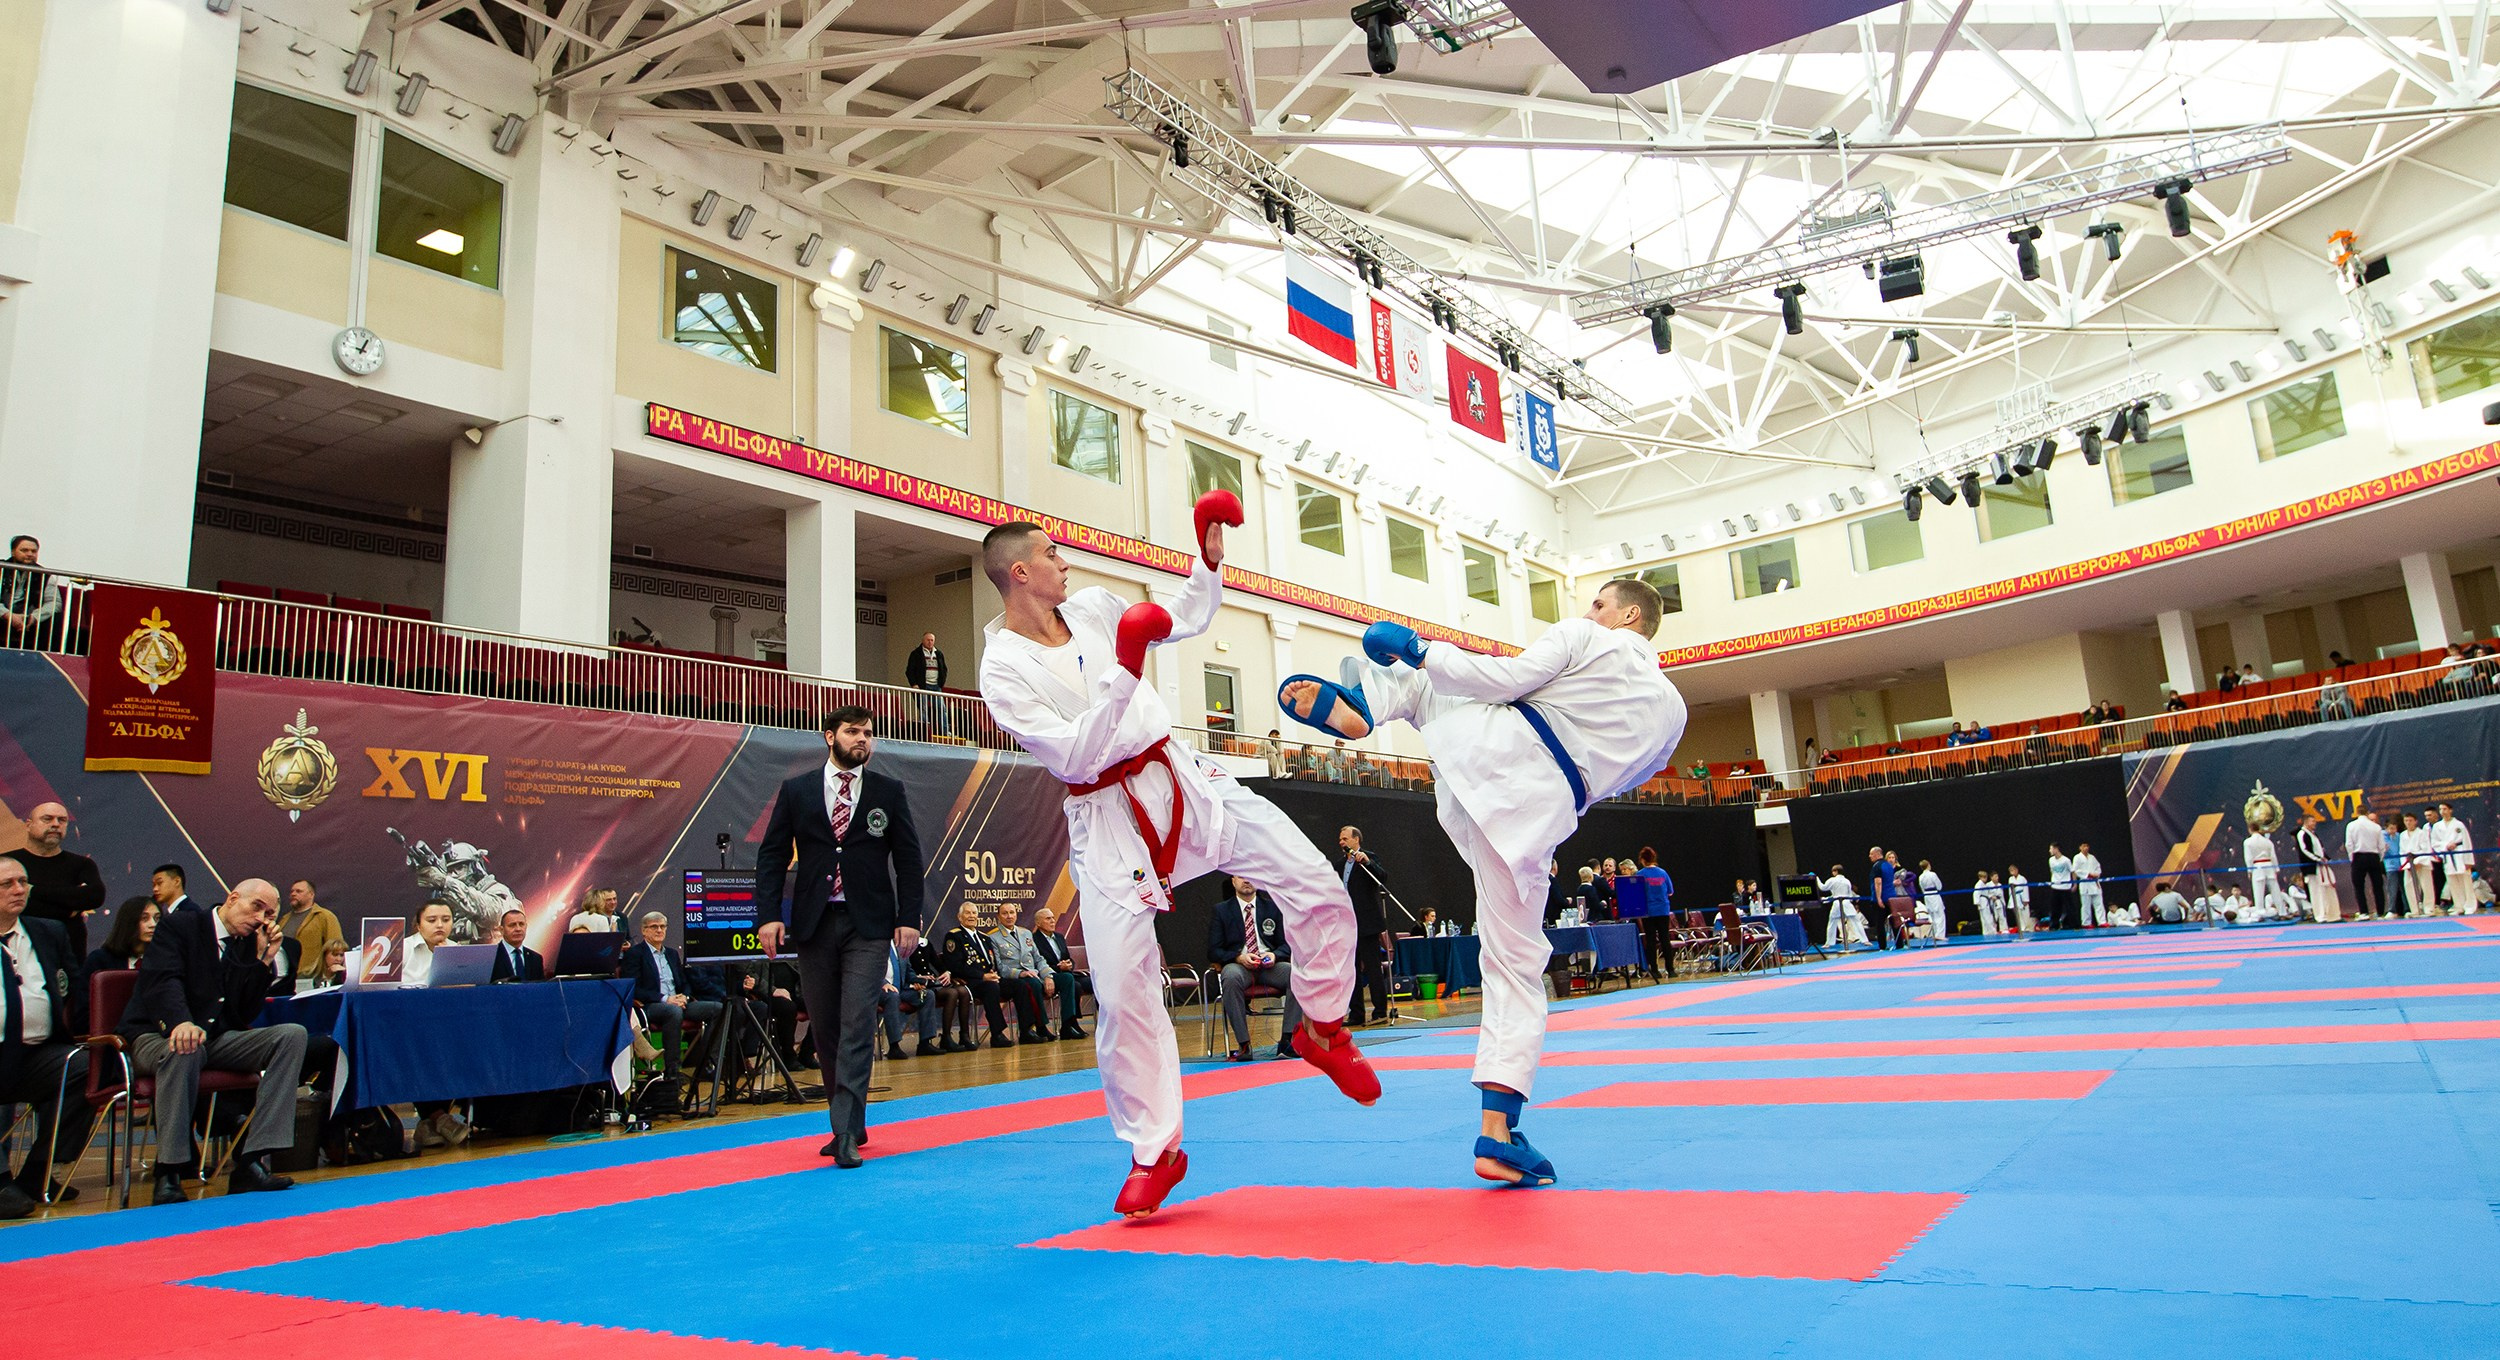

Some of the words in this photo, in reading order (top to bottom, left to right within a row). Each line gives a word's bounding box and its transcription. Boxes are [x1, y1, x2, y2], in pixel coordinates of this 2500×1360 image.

[650, 405, 686, 435] РА
[692, 416, 792, 461] "АЛЬФА"
[803, 447, 880, 486] ТУРНИР
[885, 471, 912, 495] ПО
[917, 480, 982, 514] КАРАТЭ
[986, 499, 1009, 522] НА
[1013, 507, 1063, 537] КУБОК
[1708, 627, 1800, 657] АССОЦИАЦИИ
[1803, 609, 1886, 638] ВЕТЕРАНОВ
[1889, 579, 2016, 619] ПОДРАЗДЕЛЕНИЯ
[2019, 552, 2131, 592] АНТИТЕРРОРА
[2133, 531, 2205, 561] "АЛЬФА"
[2213, 509, 2281, 541] ТУРНИР
[2285, 502, 2312, 522] ПО
[2315, 481, 2387, 513] КАРАТЭ
[2389, 469, 2418, 492] НА
[2421, 446, 2489, 481] КУБОК
[1223, 566, 1270, 591] ЦИАЦИИ
[1271, 579, 1330, 608] ВЕТЕРАНОВ
[1410, 619, 1465, 644] АНТИТЕРРОРА
[109, 721, 191, 740] "АЛЬФА"
[362, 747, 489, 802] XVI
[541, 759, 554, 768] ПО
[556, 761, 586, 771] КАРАТЭ
[588, 763, 599, 772] НА
[601, 764, 627, 773] КУБОК
[583, 775, 637, 786] АССОЦИАЦИИ
[639, 779, 681, 789] ВЕТЕРАНОВ
[505, 781, 588, 796] ПОДРАЗДЕЛЕНИЯ
[590, 788, 655, 799] АНТИТЕРРОРА
[2292, 789, 2364, 822] XVI
[964, 851, 997, 885] 50
[1002, 867, 1036, 885] лет
[964, 889, 1036, 901] ПОДРАЗДЕЛЕНИЮ
[369, 935, 392, 974] 2
